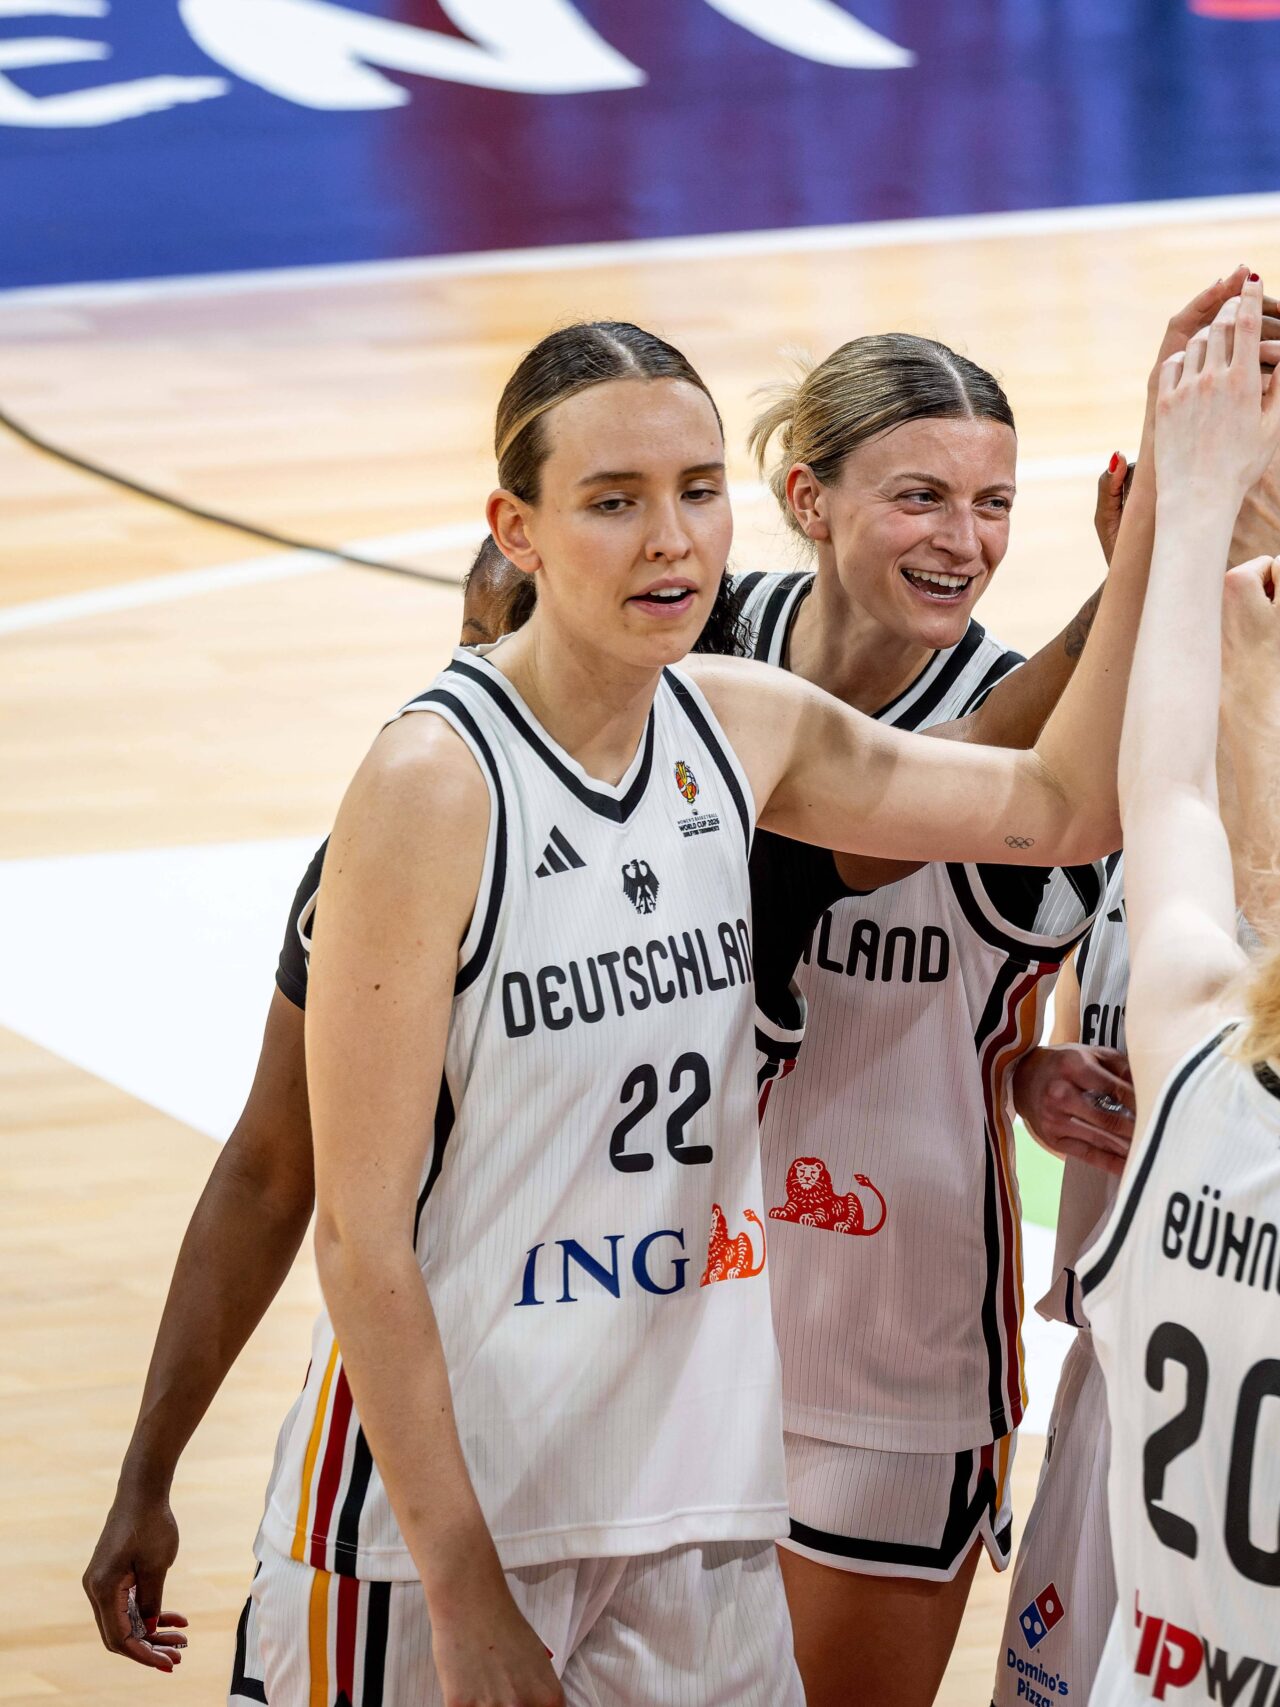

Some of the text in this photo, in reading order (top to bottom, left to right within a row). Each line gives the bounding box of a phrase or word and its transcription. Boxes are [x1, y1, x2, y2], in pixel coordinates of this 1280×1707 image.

[678, 822, 697, 832] WORLD
[697, 820, 707, 829] CUP
[609, 1051, 713, 1173] 22
[514, 1228, 690, 1306] ING
[1007, 1647, 1069, 1696] Domino's
[1016, 1677, 1052, 1707] Pizza
